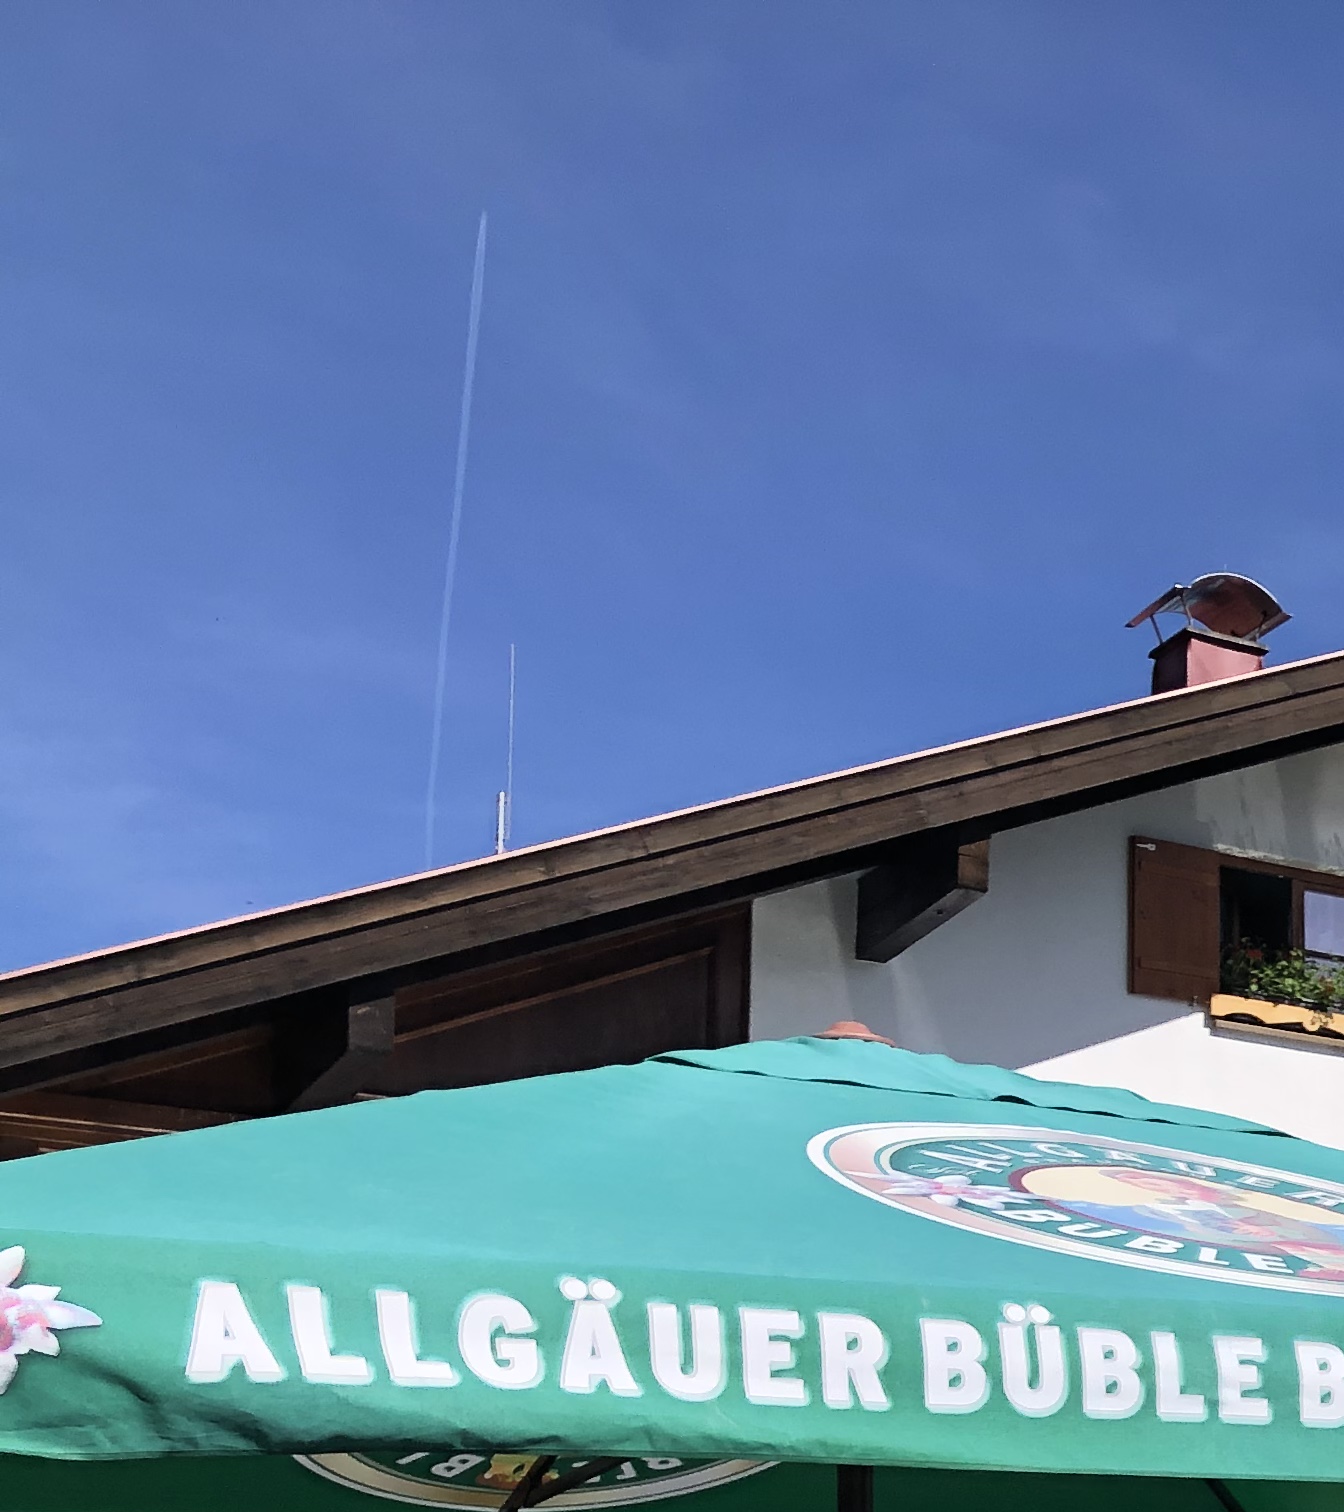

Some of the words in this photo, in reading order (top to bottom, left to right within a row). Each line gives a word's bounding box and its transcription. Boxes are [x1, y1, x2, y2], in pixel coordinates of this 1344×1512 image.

[1000, 1208, 1295, 1274] BÜBLE
[185, 1275, 892, 1411] ALLGÄUER
[919, 1301, 1273, 1425] BÜBLE
